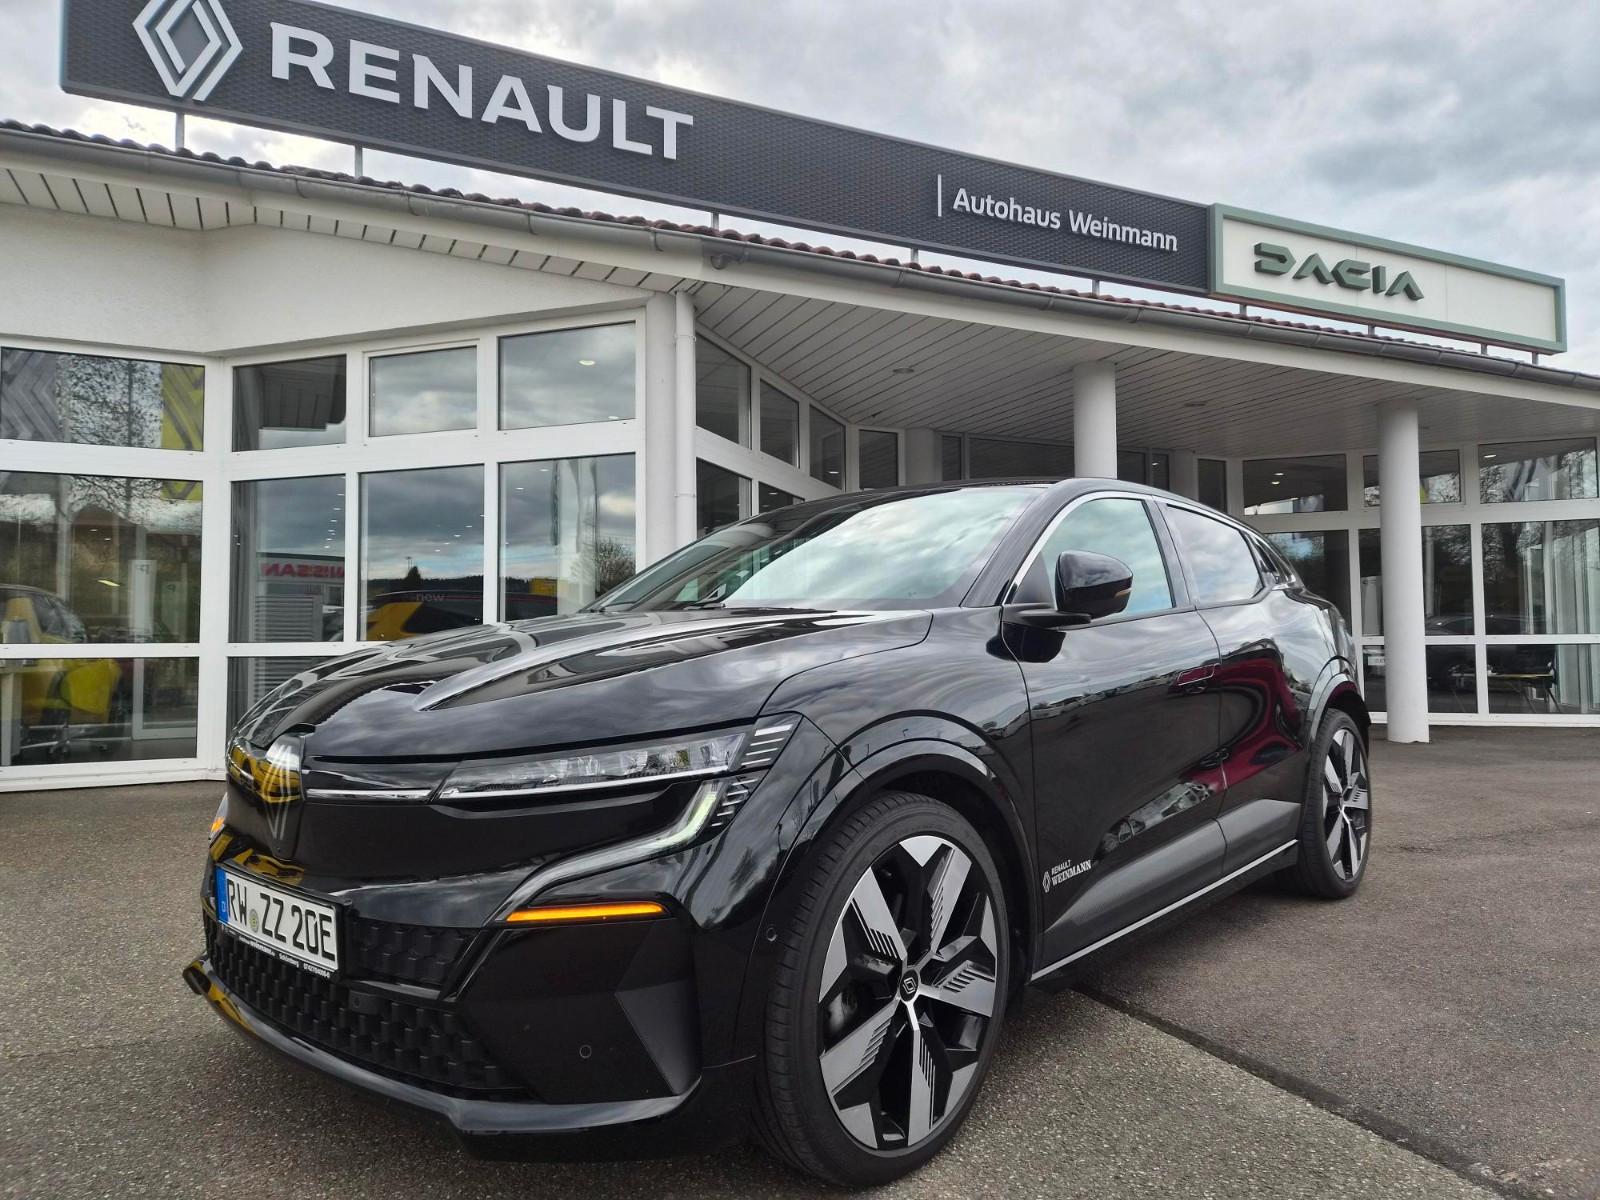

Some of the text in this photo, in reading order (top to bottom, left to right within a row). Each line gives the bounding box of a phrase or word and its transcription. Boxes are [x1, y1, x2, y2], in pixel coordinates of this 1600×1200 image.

[272, 22, 694, 160] RENAULT
[953, 188, 1178, 251] Autohaus Weinmann
[1254, 242, 1424, 301] DACIA
[1051, 859, 1092, 886] WEINMANN
[227, 879, 247, 926] RW
[260, 893, 287, 943] ZZ
